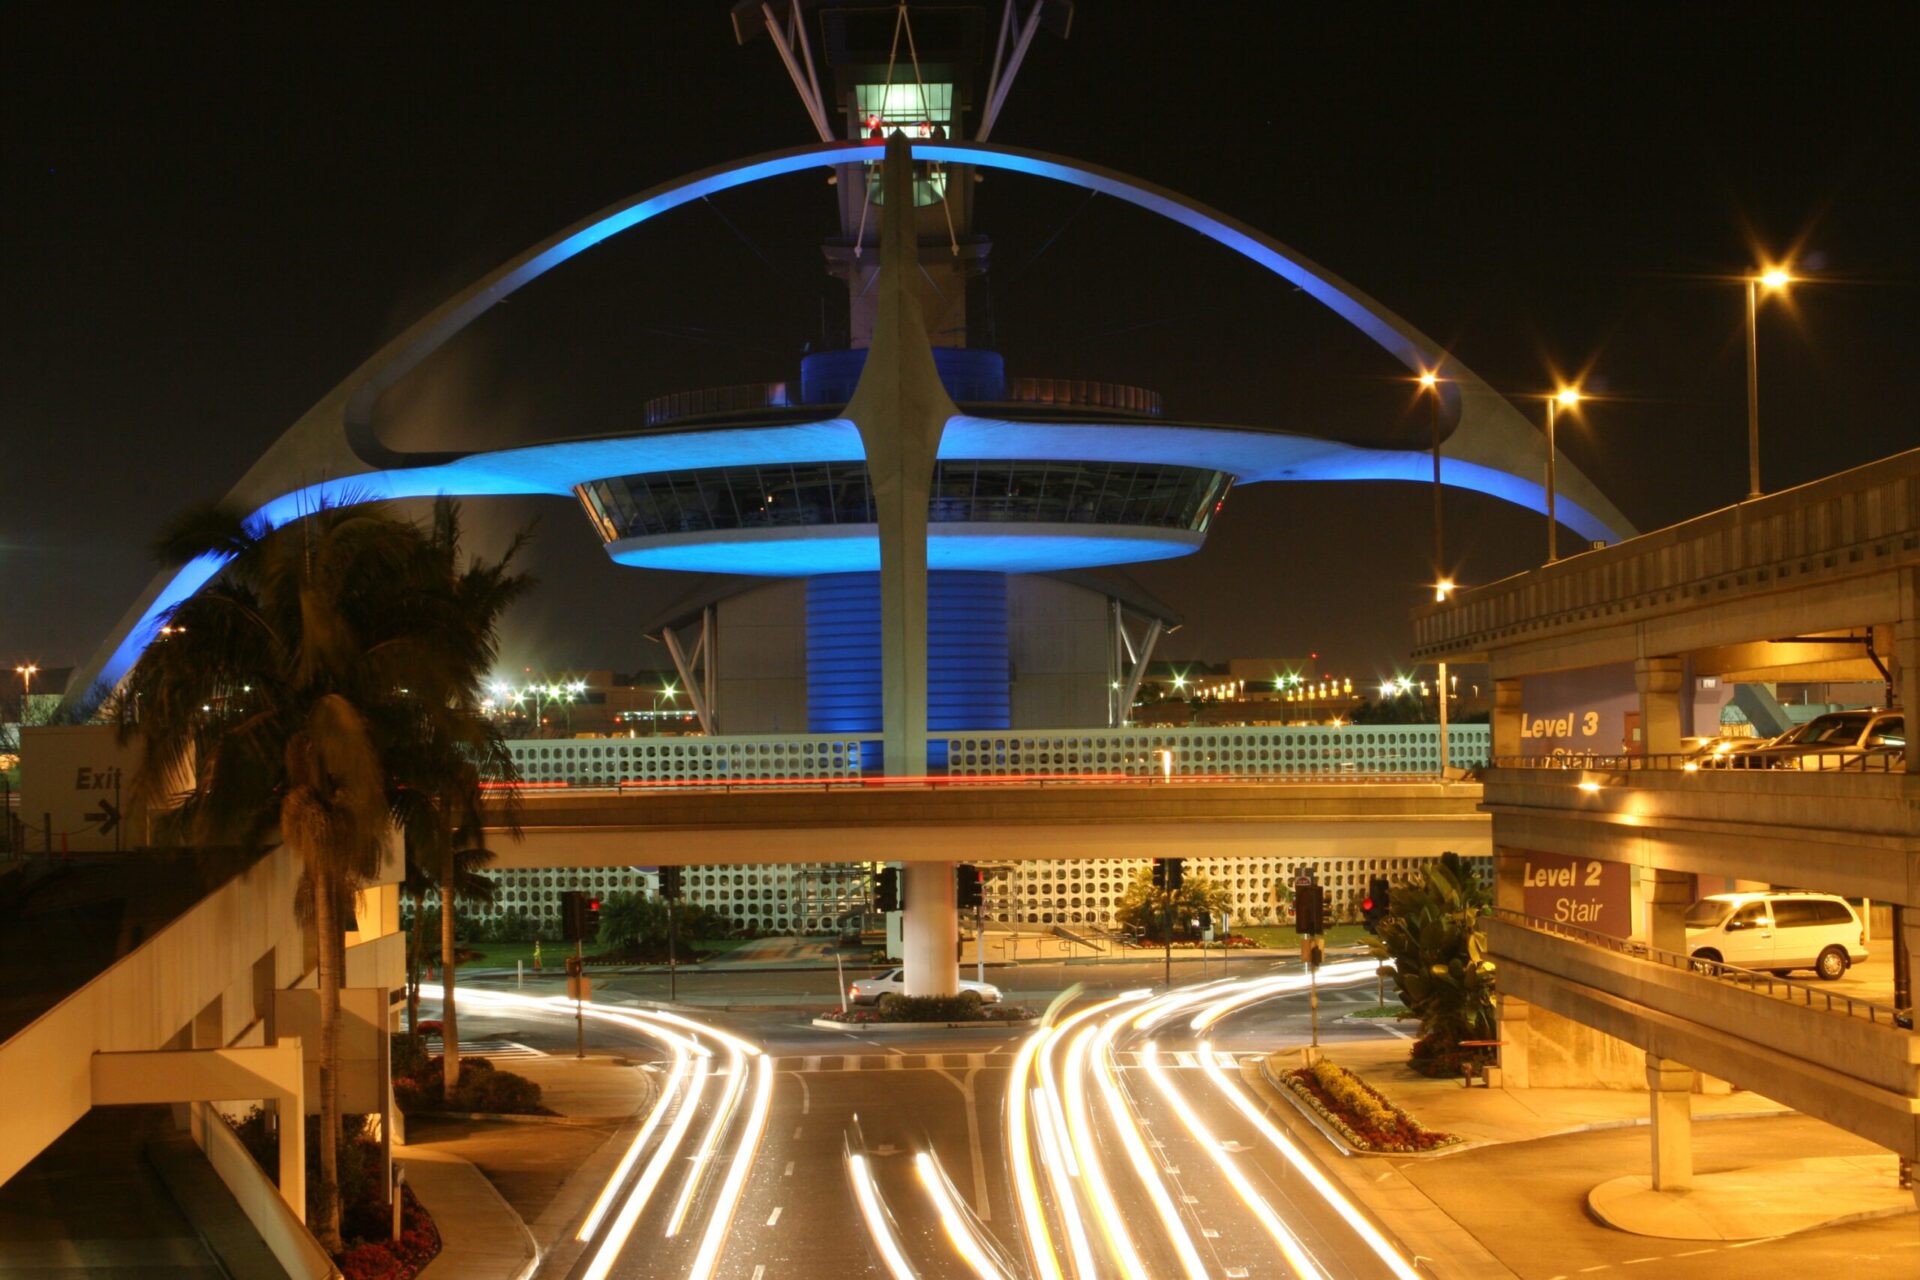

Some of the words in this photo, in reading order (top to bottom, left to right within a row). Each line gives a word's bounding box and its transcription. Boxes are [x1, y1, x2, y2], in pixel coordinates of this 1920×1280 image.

[1521, 712, 1575, 738] Level
[1582, 711, 1599, 736] 3
[76, 766, 122, 790] Exit
[1523, 862, 1577, 888] Level
[1584, 861, 1602, 886] 2
[1554, 898, 1603, 922] Stair
